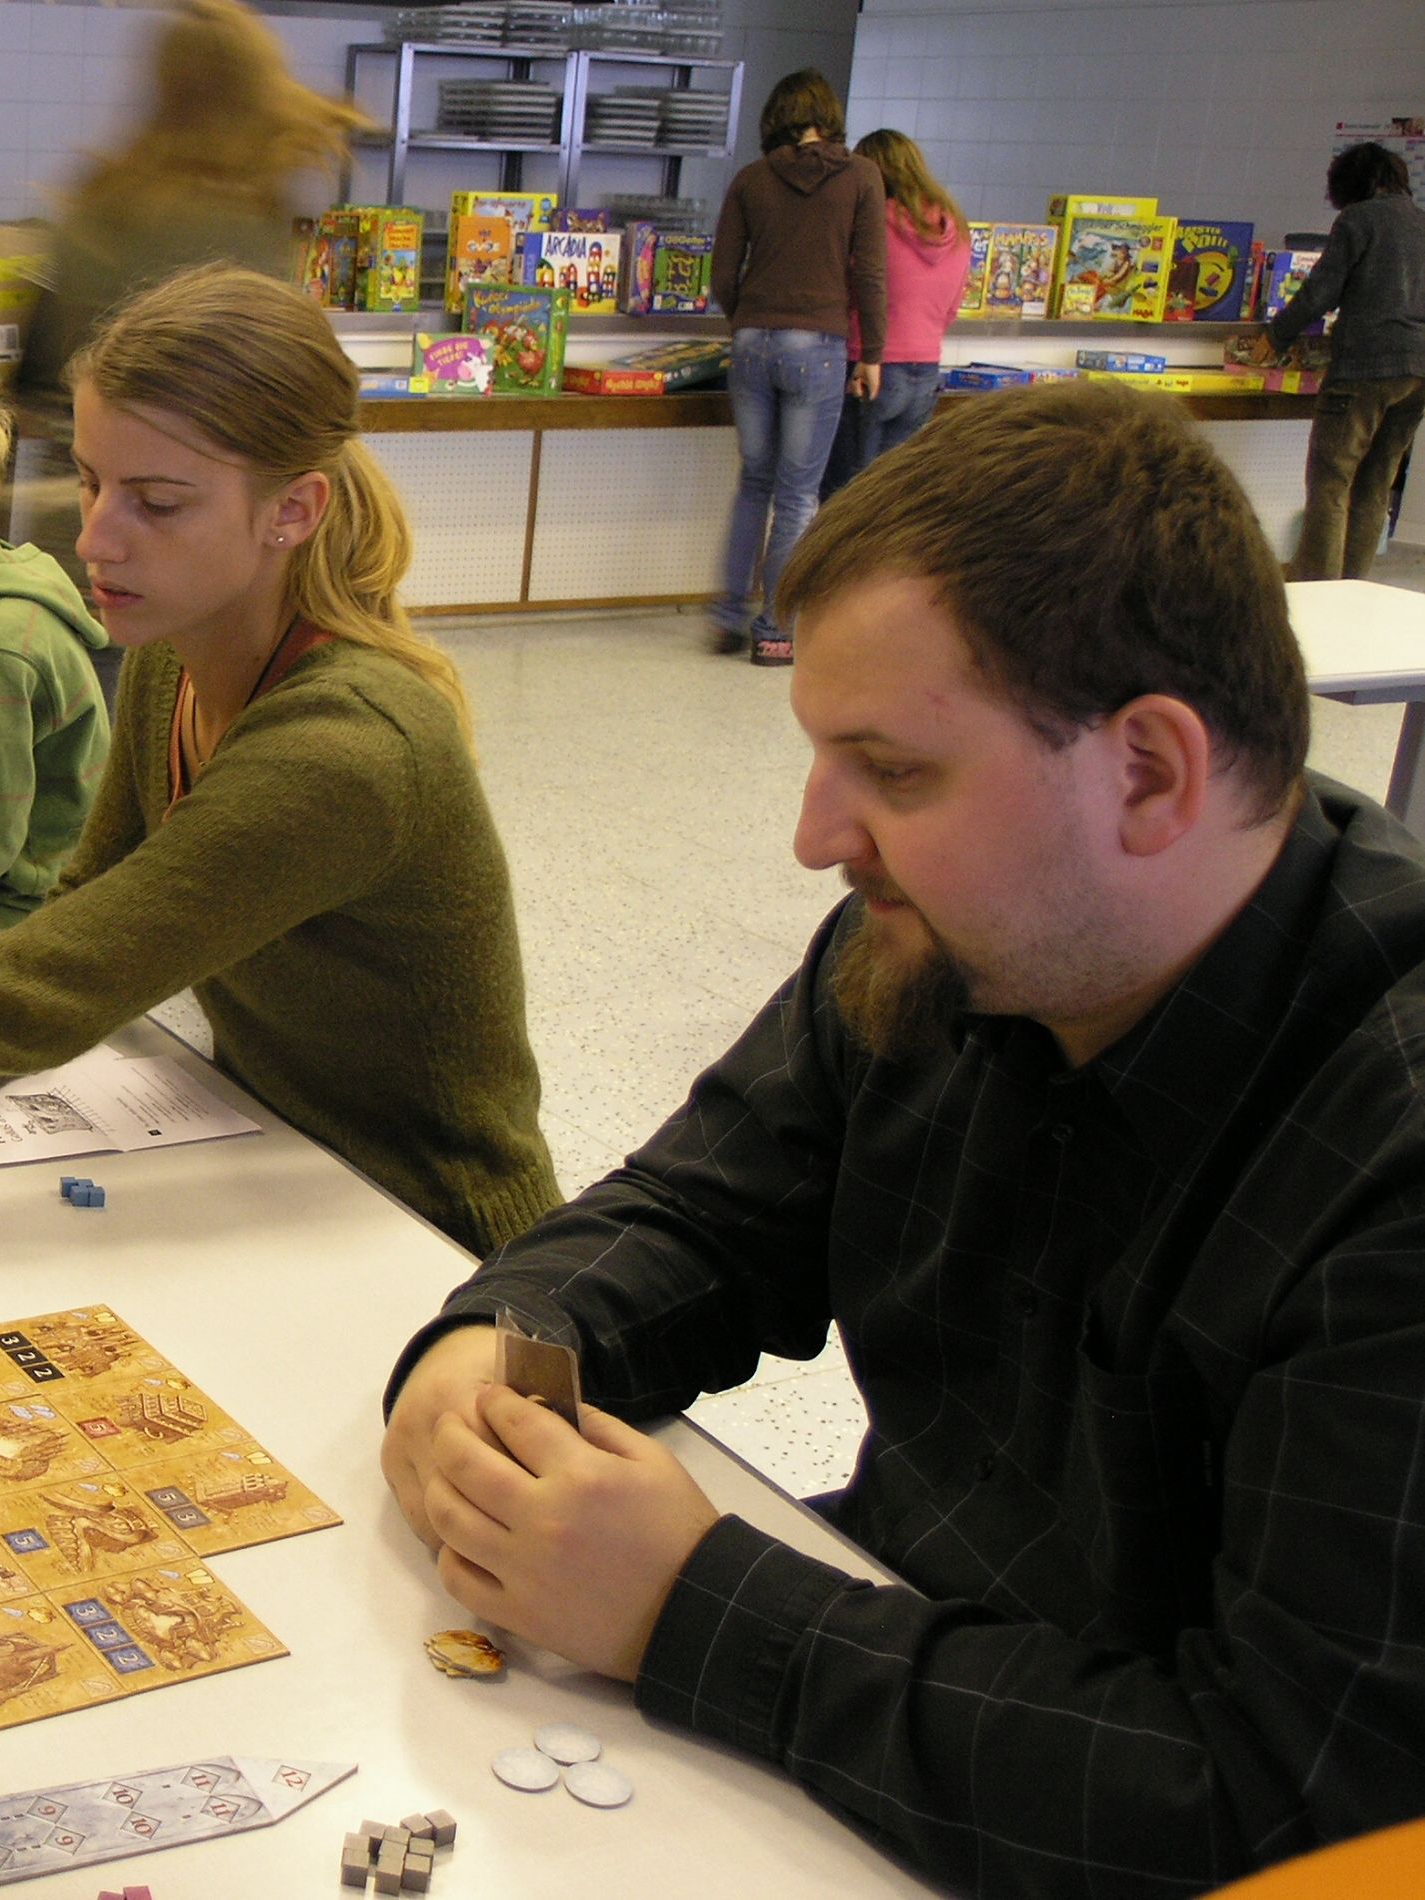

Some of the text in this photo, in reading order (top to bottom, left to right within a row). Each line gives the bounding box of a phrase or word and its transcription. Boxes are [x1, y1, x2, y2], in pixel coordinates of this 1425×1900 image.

[544, 234, 587, 258] ARCADIA
[191, 1773, 212, 1790] 11
[281, 1769, 304, 1789] 12
[111, 1787, 135, 1806] 10
[37, 1804, 57, 1816] 9
[211, 1801, 231, 1818] 11
[130, 1816, 153, 1836] 10
[54, 1834, 75, 1846] 9
